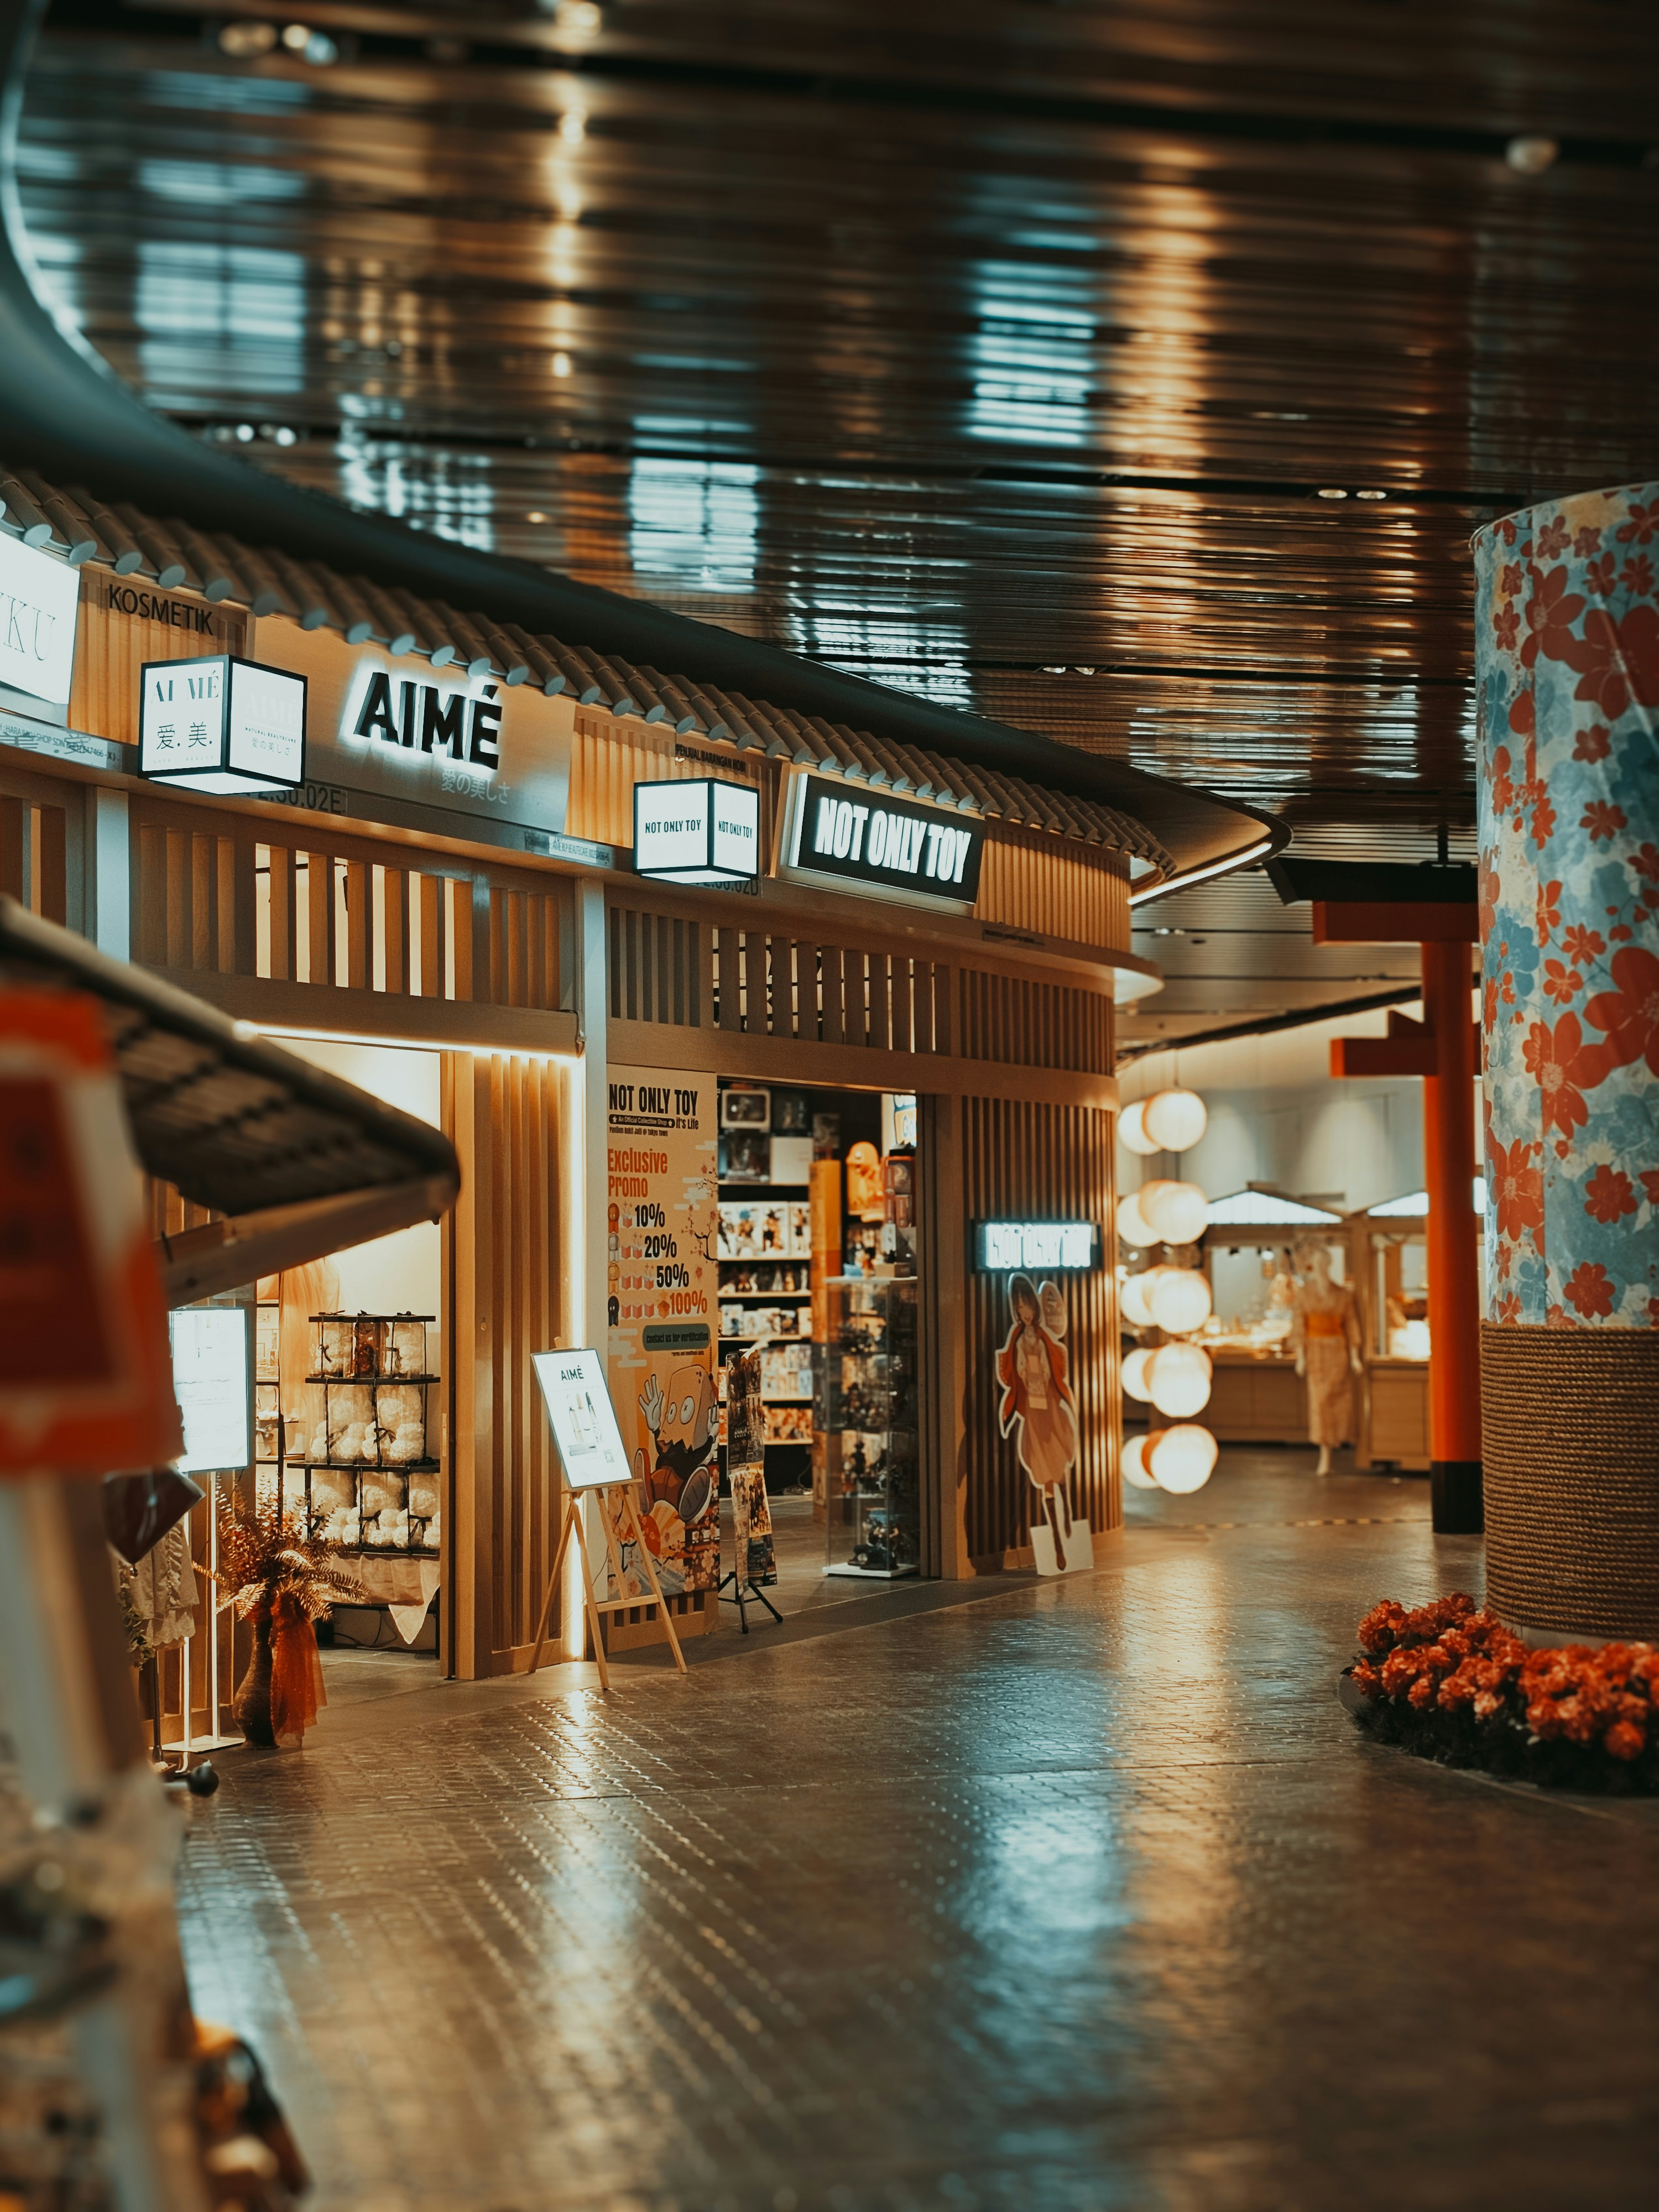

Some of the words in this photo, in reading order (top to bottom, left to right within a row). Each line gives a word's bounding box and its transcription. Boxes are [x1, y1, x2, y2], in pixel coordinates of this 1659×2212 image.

[109, 584, 213, 635] KOSMETIK
[0, 591, 56, 661] KU
[353, 672, 502, 770] AIMÉ
[645, 821, 661, 833] NOT
[664, 821, 683, 833] ONLY
[686, 820, 701, 831] TOY
[719, 821, 728, 833] NOT
[730, 823, 742, 836] ONLY
[743, 826, 753, 839] TOY
[815, 797, 869, 861] NOT
[868, 810, 927, 873] ONLY
[926, 823, 972, 883] TOY
[609, 1083, 634, 1111] NOT
[639, 1086, 670, 1114] ONLY
[674, 1089, 698, 1116] TOY
[687, 1118, 699, 1130] Life
[608, 1147, 667, 1173] Exclusive
[608, 1175, 648, 1198] Promo
[635, 1203, 665, 1228] 10%
[644, 1233, 677, 1258] 20%
[656, 1263, 689, 1287] 50%
[670, 1290, 707, 1314] 100%
[561, 1365, 584, 1381] AIMÉ
